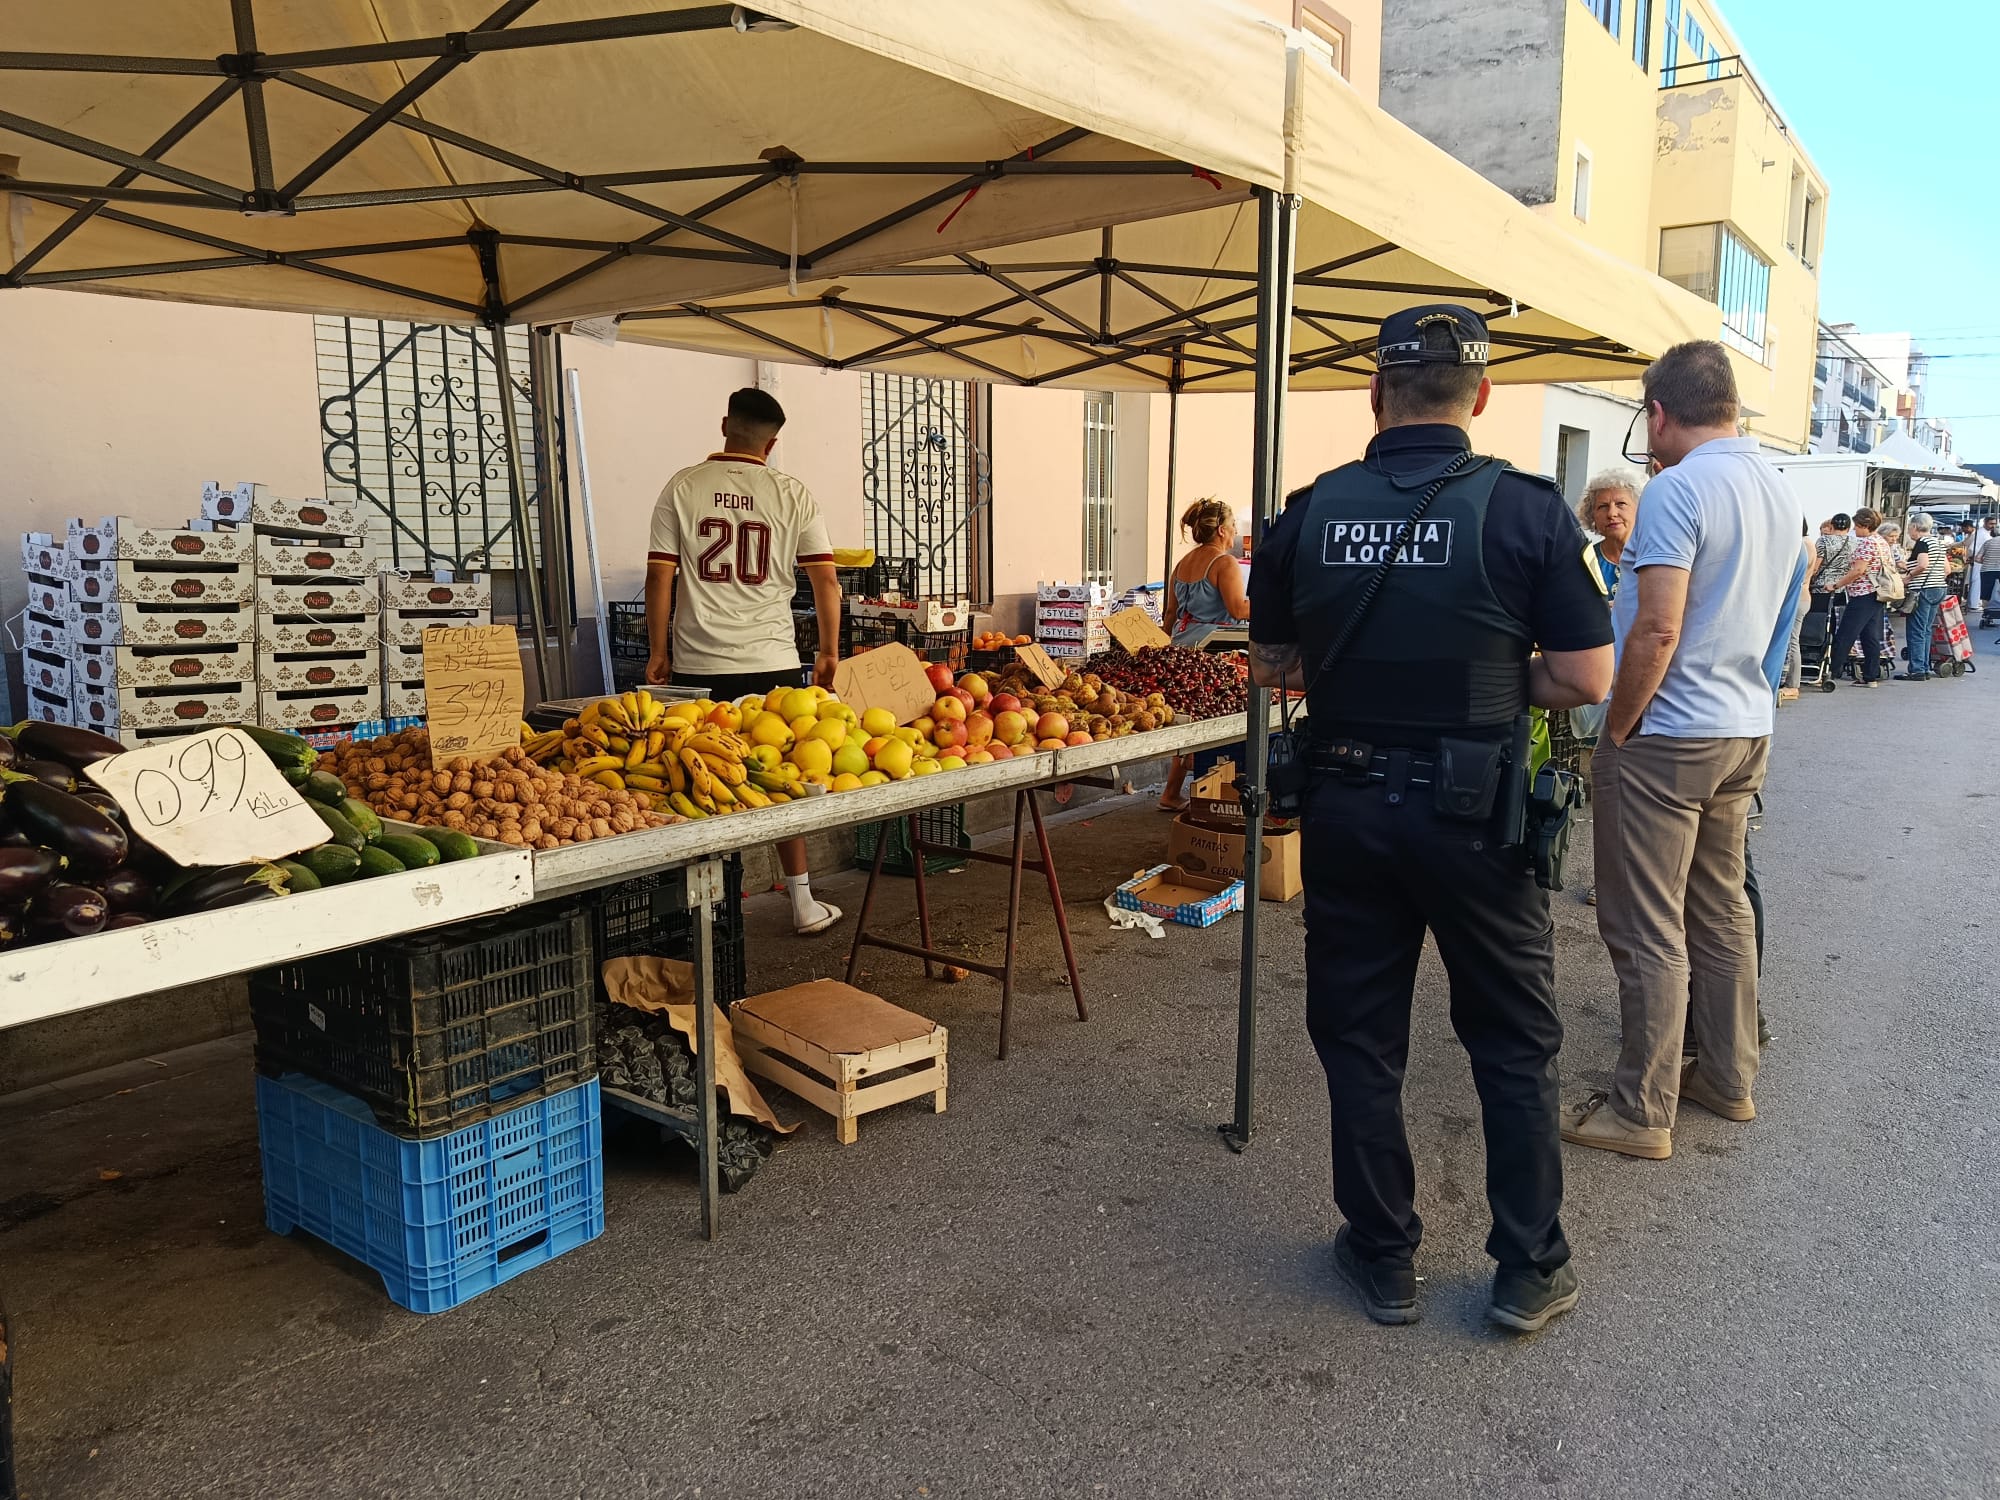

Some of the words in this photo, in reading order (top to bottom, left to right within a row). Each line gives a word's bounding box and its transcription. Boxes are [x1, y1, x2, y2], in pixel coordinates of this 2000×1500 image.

[714, 492, 754, 511] PEDRI
[697, 516, 772, 586] 20
[1344, 545, 1425, 563] LOCAL
[1046, 609, 1075, 618] STYLE
[1045, 628, 1073, 637] STYLE
[1045, 646, 1073, 656] STYLE
[1190, 836, 1230, 853] PATATAS
